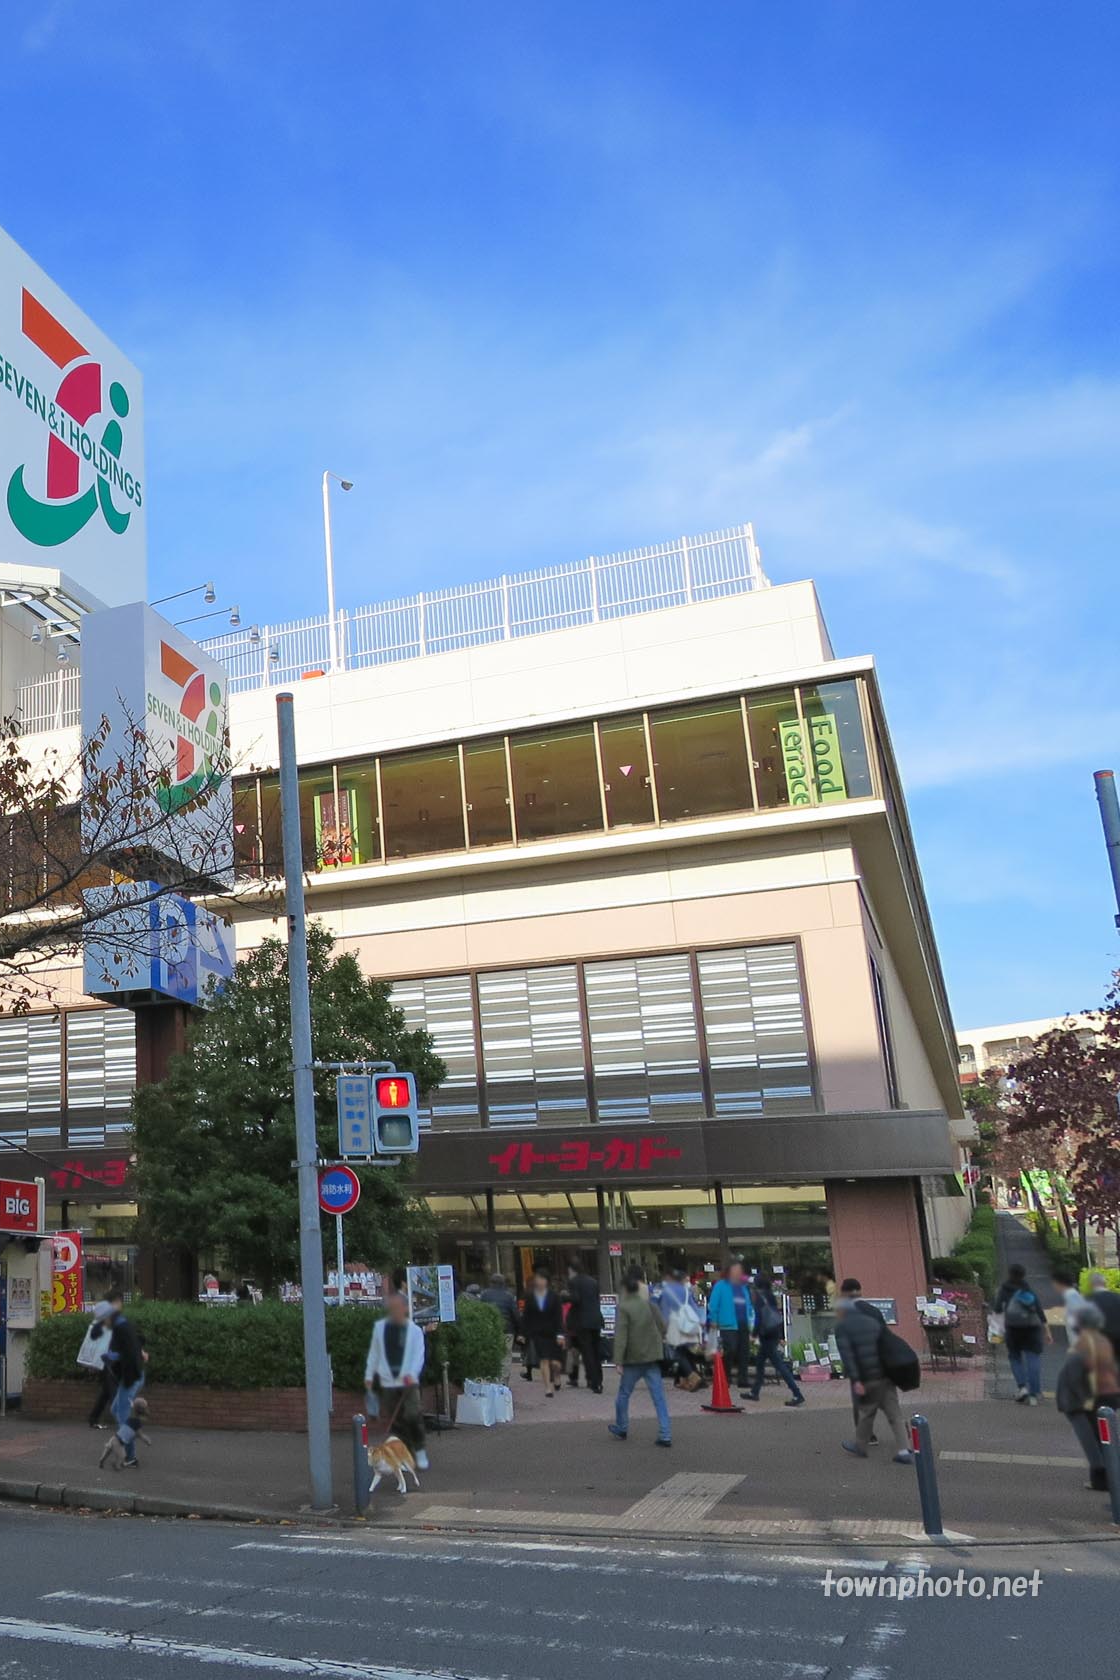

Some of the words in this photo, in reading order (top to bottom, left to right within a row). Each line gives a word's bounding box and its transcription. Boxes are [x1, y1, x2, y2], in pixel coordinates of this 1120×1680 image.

[70, 420, 142, 508] HOLDINGS
[188, 721, 226, 758] HOLDIN
[812, 720, 843, 794] Food
[489, 1137, 683, 1175] イトーヨーカドー
[5, 1188, 30, 1216] BIG
[321, 1184, 352, 1194] 消防水利
